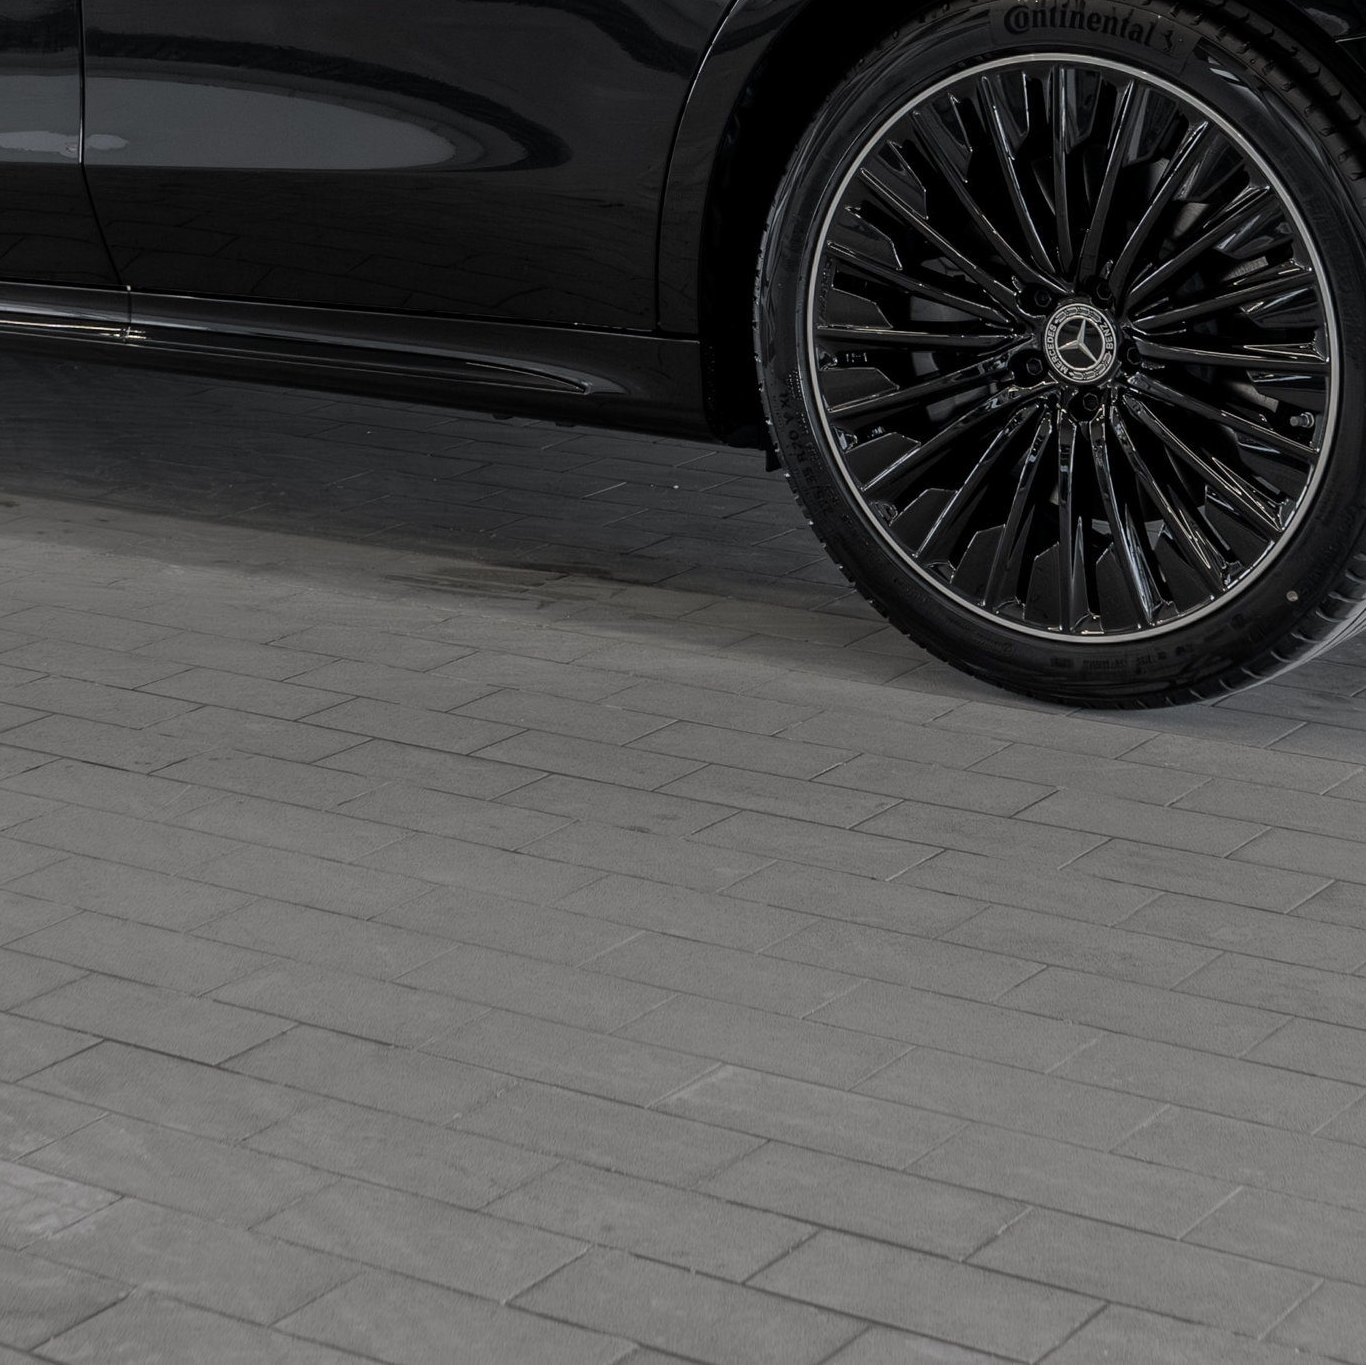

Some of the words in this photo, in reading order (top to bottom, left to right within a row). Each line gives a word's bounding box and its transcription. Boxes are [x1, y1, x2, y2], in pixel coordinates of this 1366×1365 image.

[1002, 1, 1159, 48] Continental
[1047, 324, 1069, 374] MERCEDES
[1099, 321, 1114, 350] BENZ
